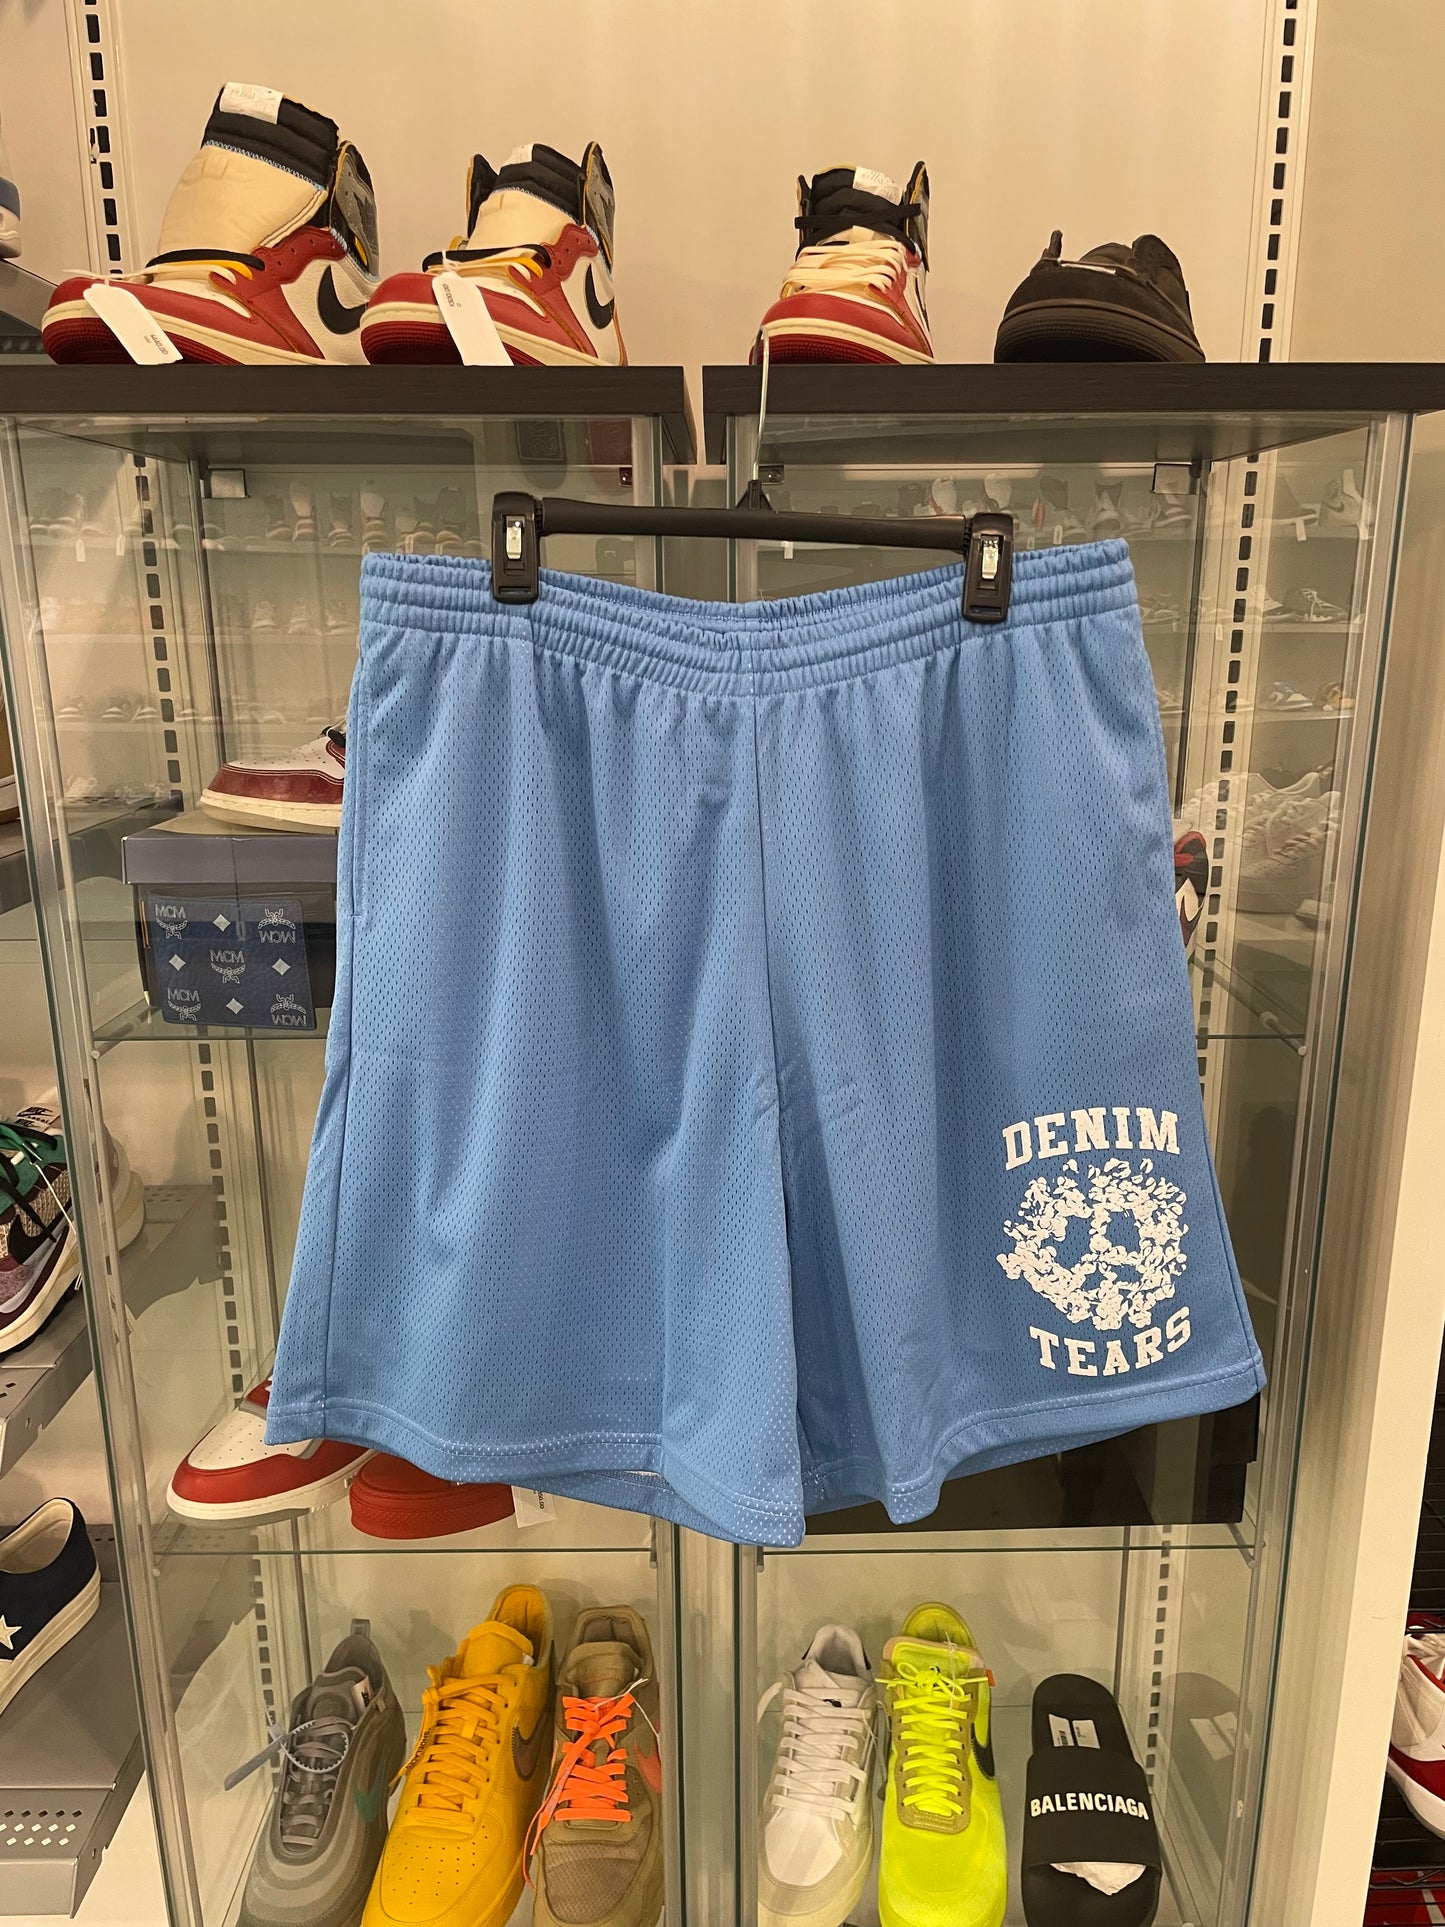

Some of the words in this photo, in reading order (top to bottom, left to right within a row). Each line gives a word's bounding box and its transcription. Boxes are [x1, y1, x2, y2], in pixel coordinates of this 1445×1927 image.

[155, 904, 187, 919] MCM
[258, 930, 296, 944] MCM
[210, 950, 245, 964] MCM
[167, 987, 200, 1002] MCM
[271, 1014, 307, 1027] MCM
[1002, 1106, 1180, 1171] DENIM
[1029, 1306, 1191, 1377] TEARS
[1030, 1792, 1149, 1821] BALENCIAGA
